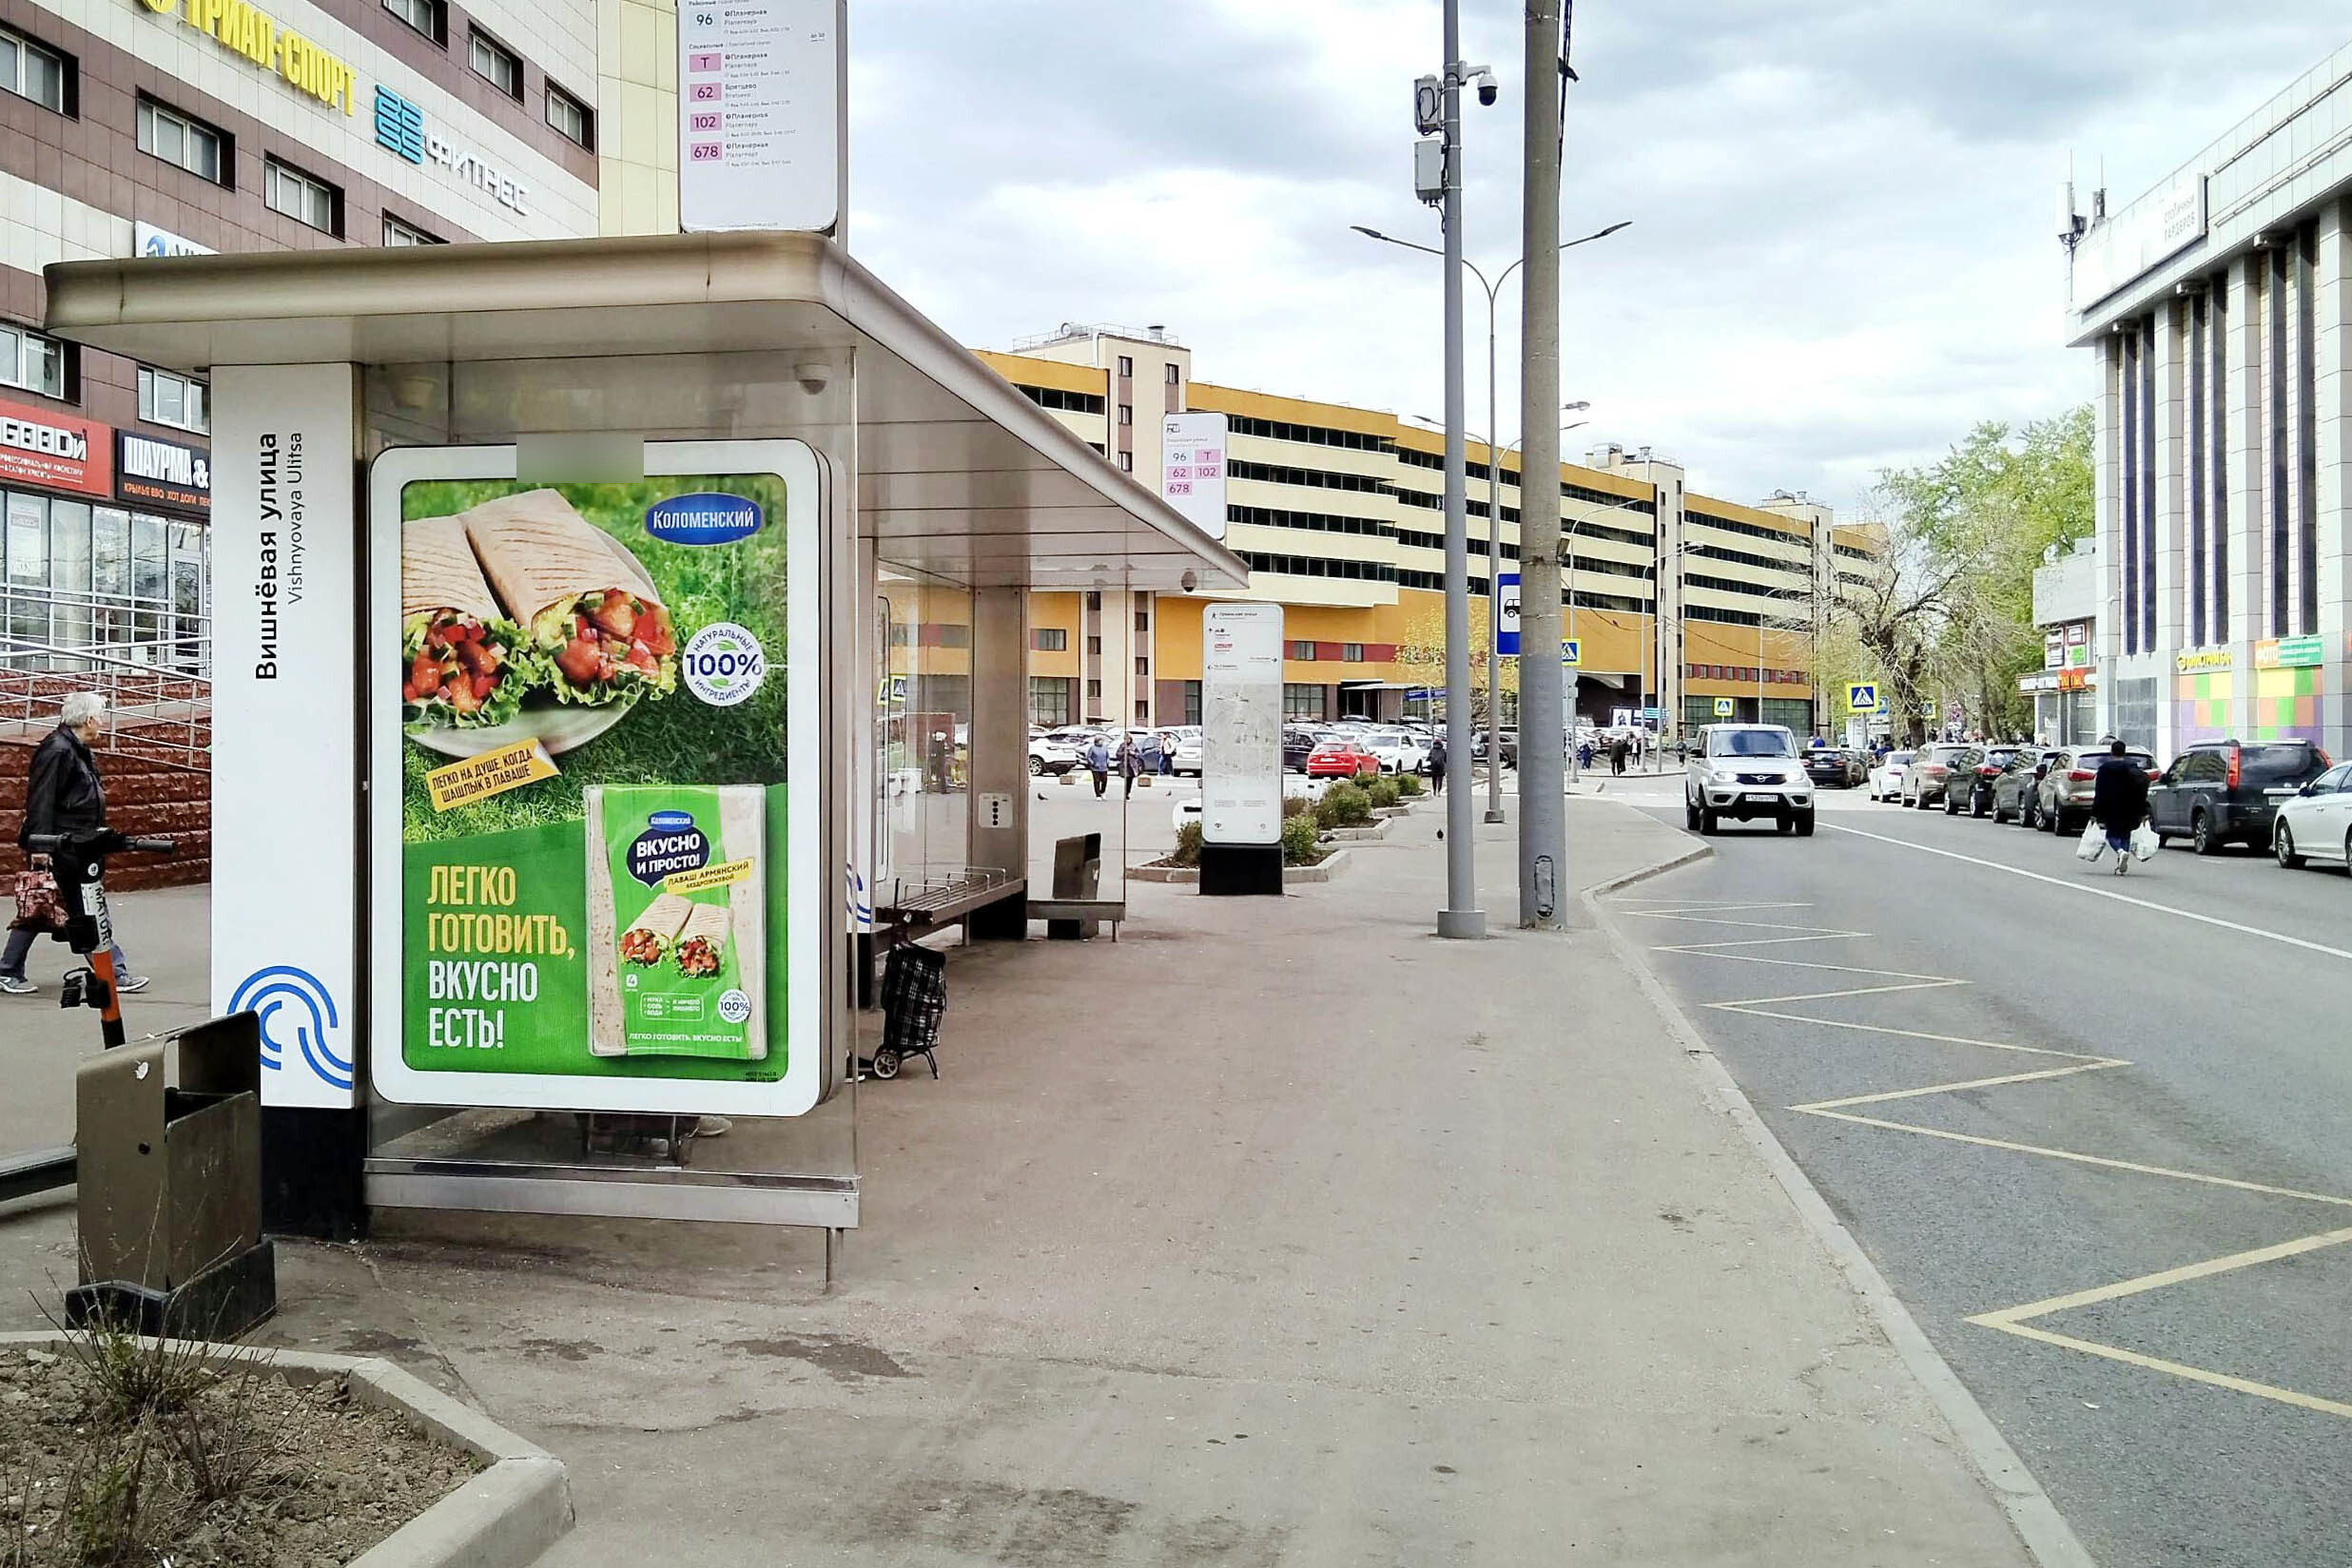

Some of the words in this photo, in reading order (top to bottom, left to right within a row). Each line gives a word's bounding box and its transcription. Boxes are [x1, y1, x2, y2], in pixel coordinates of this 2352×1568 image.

[696, 13, 713, 27] 96
[697, 87, 714, 99] 62
[694, 117, 716, 129] 102
[693, 145, 719, 159] 678
[428, 131, 530, 217] ФИТНЕС
[124, 436, 193, 486] ШАУРМА
[193, 459, 209, 489] &
[287, 432, 302, 484] Ulitsa
[1172, 452, 1187, 462] 96
[260, 433, 282, 521] улица
[1173, 468, 1187, 478] 62
[1197, 467, 1216, 477] 102
[1169, 484, 1190, 494] 678
[287, 490, 306, 605] Vishnyovaya
[255, 531, 279, 680] Вишнёвая
[693, 629, 754, 652] НАТУРАЛЬНЫЕ
[686, 653, 762, 676] 100%
[694, 679, 751, 701] ИНГРЕДИЕНТЫ
[432, 772, 459, 790] ЛЕГКО
[460, 767, 473, 780] НА
[503, 747, 534, 767] КОГДА
[441, 779, 485, 803] ШАШЛЫК
[486, 778, 492, 789] В
[493, 764, 531, 787] ЛАВАШЕ
[636, 833, 701, 859] ВКУСНО
[636, 861, 647, 875] И
[649, 853, 700, 874] ПРОСТО!
[668, 872, 697, 886] ЛАВАШ
[699, 861, 749, 880] АРМЯНСКИЙ
[427, 865, 517, 907] ЛЕГКО
[428, 913, 575, 960] ГОТОВИТЬ,
[428, 959, 538, 1003] ВКУСНО
[720, 1001, 750, 1012] 100%
[428, 1006, 504, 1050] ЕСТЬ!
